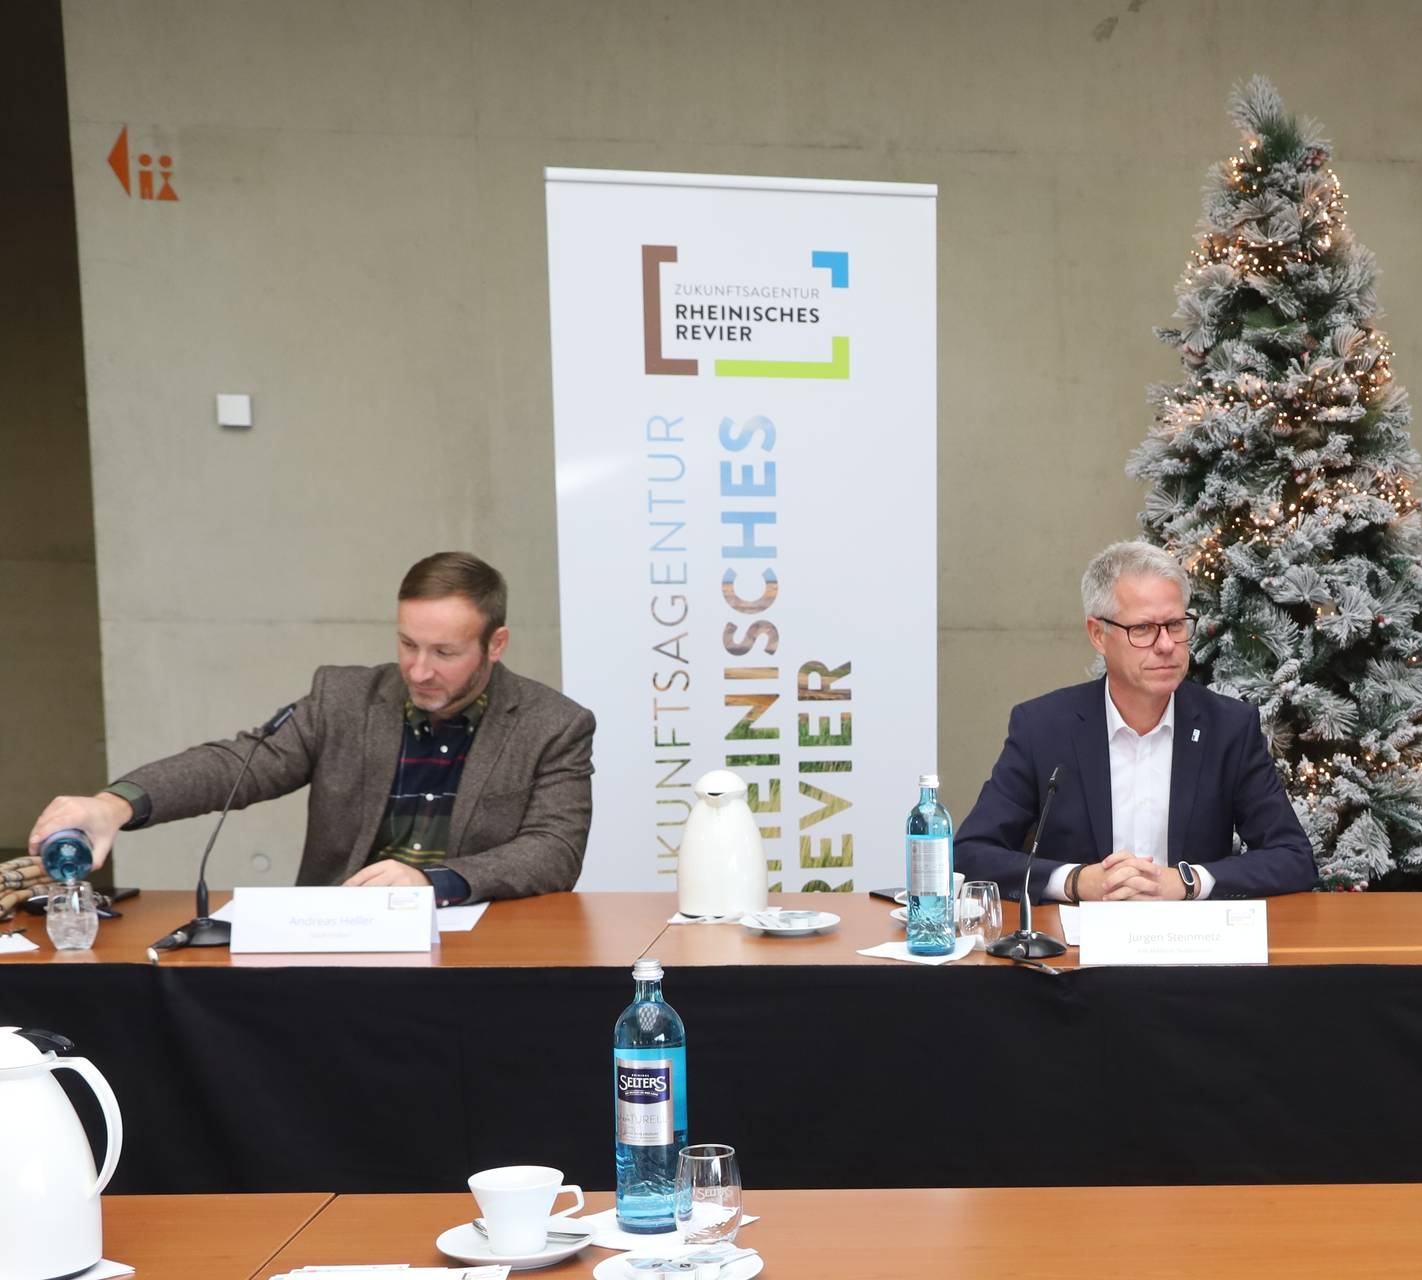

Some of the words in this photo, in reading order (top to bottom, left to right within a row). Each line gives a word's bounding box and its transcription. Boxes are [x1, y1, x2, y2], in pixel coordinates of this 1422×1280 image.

[674, 283, 820, 300] ZUKUNFTSAGENTUR
[675, 304, 820, 324] RHEINISCHES
[676, 325, 752, 342] REVIER
[646, 415, 693, 875] KUNFTSAGENTUR
[718, 415, 783, 893] EINISCHES
